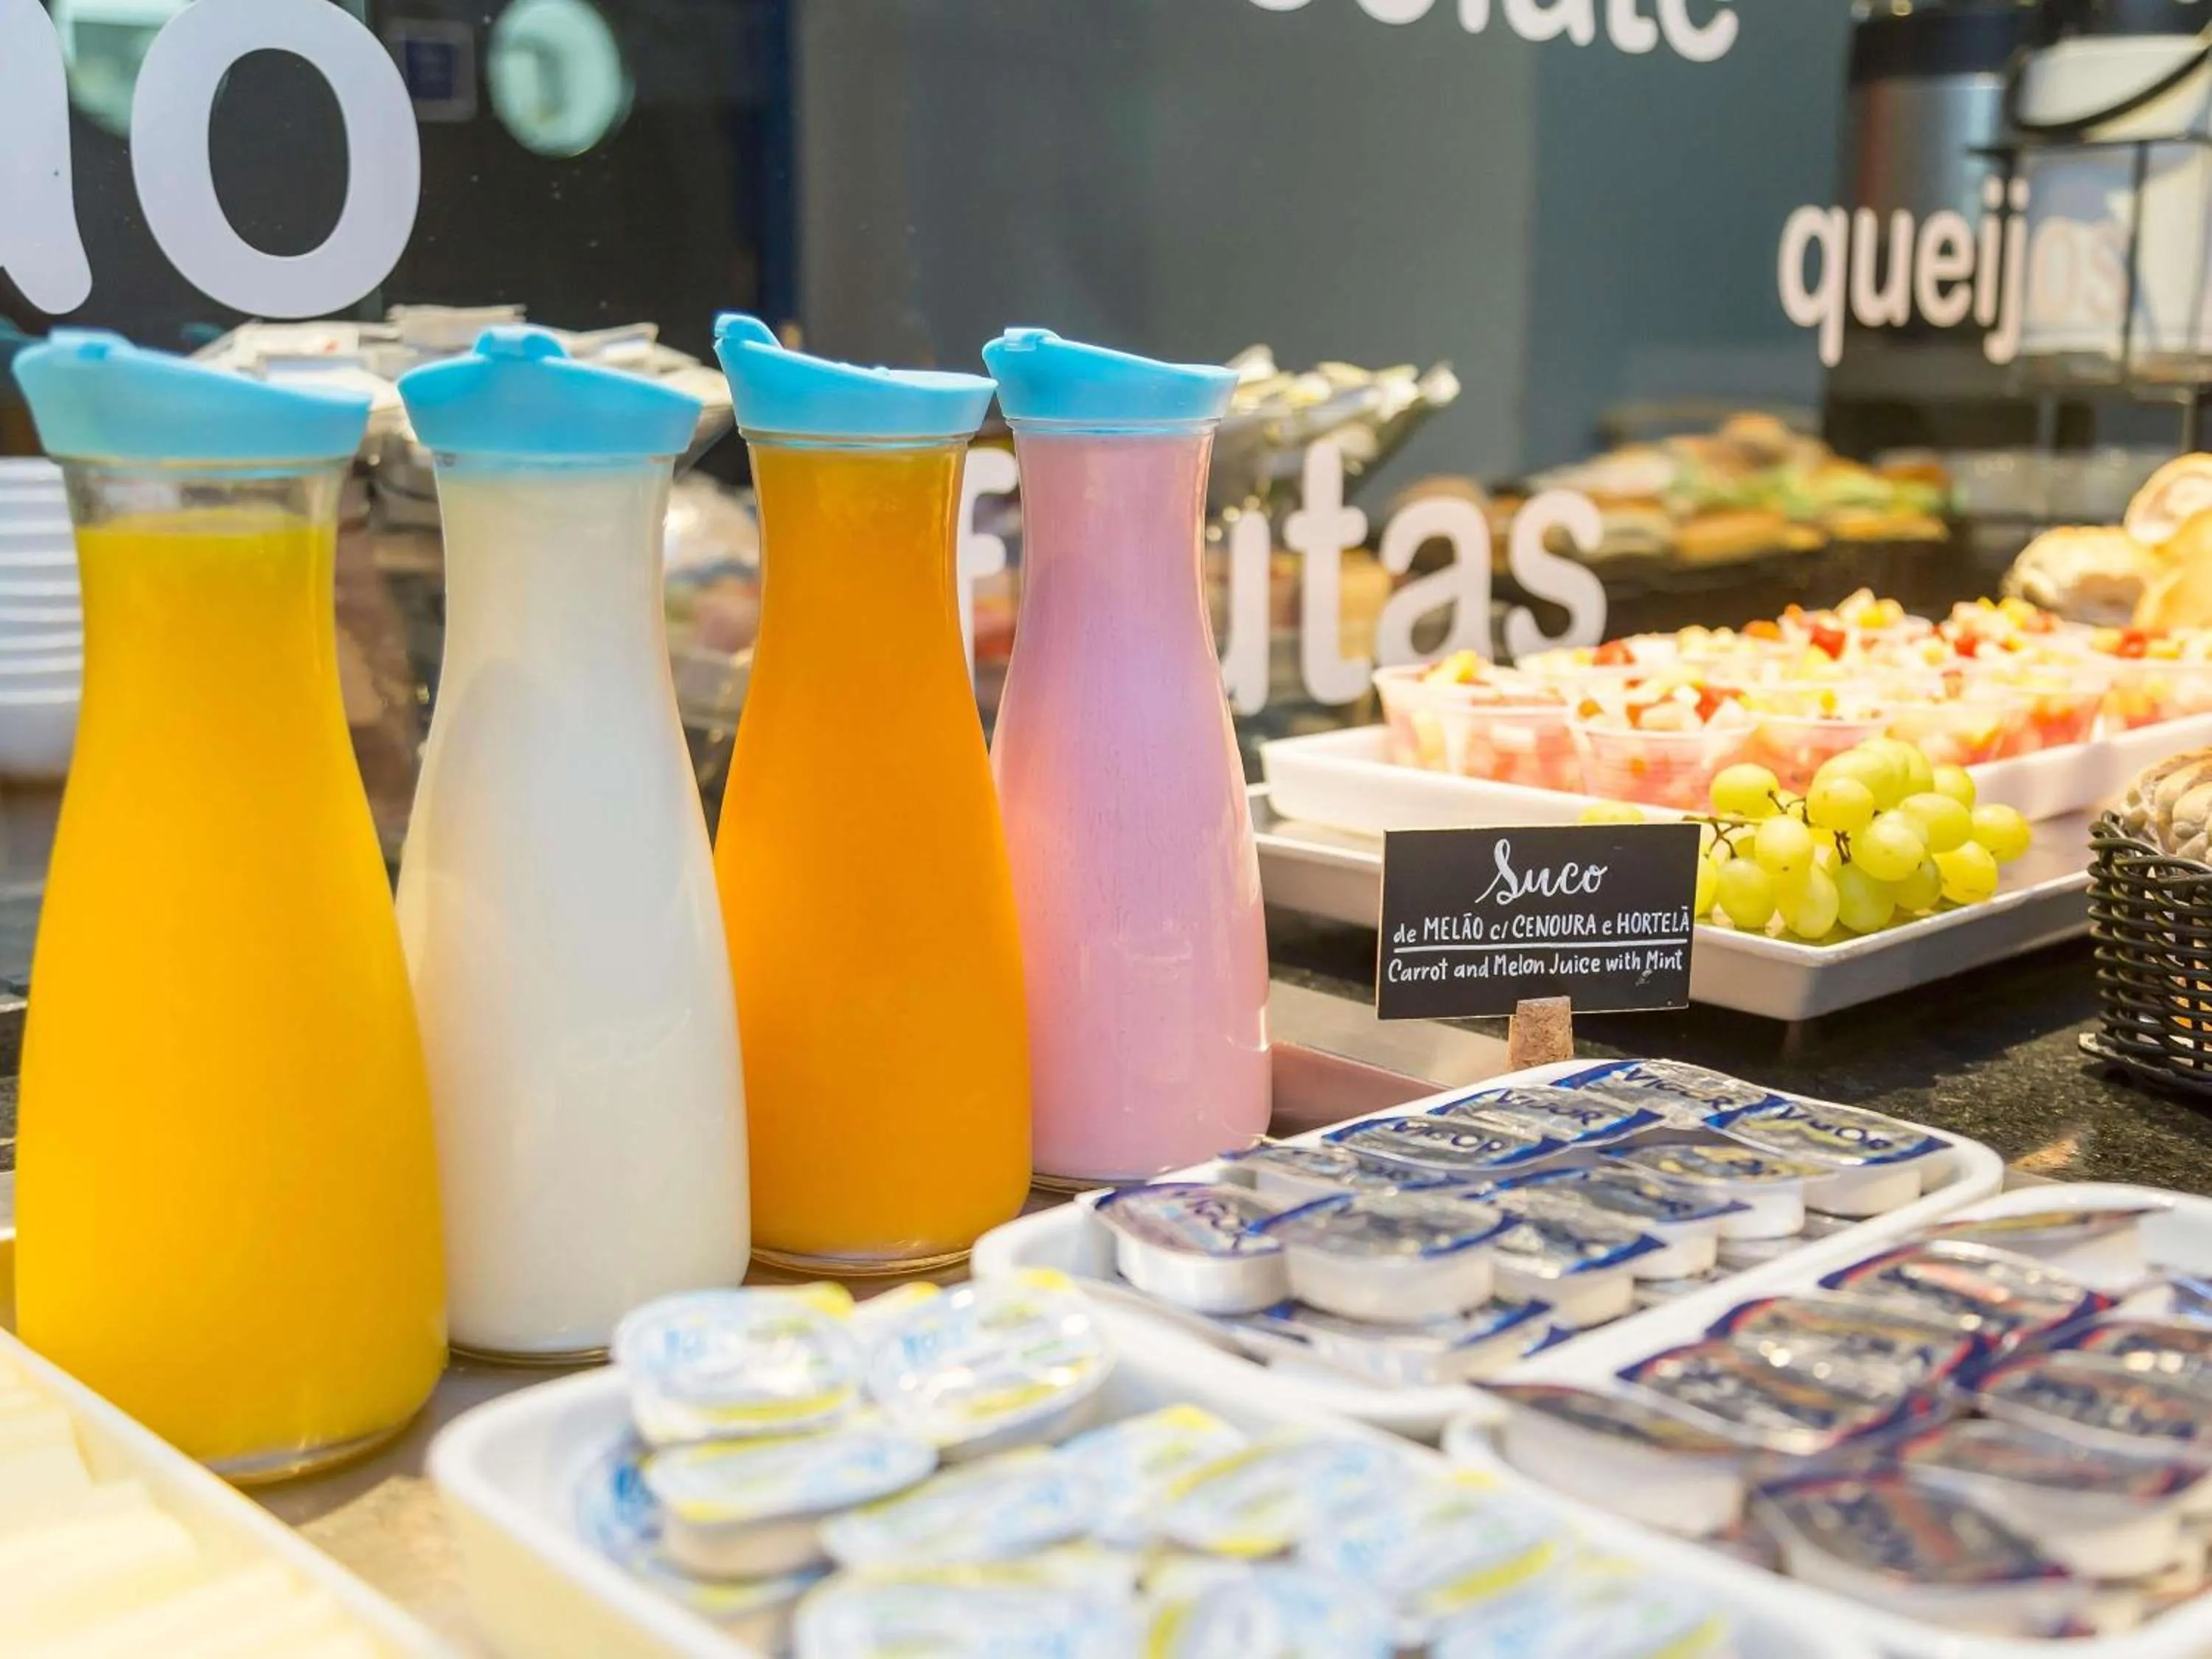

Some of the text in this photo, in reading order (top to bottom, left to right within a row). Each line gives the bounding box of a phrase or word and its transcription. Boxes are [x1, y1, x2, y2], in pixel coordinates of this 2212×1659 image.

[1778, 175, 2129, 367] queijos
[957, 438, 1607, 715] ftas
[1475, 838, 1608, 905] Suco
[1394, 922, 1416, 944] de
[1423, 911, 1484, 942] MELÃO
[1601, 919, 1613, 935] e
[1616, 905, 1690, 936] HORTELÃ
[1388, 948, 1683, 983] Carrot and Melon Juice with Mint
